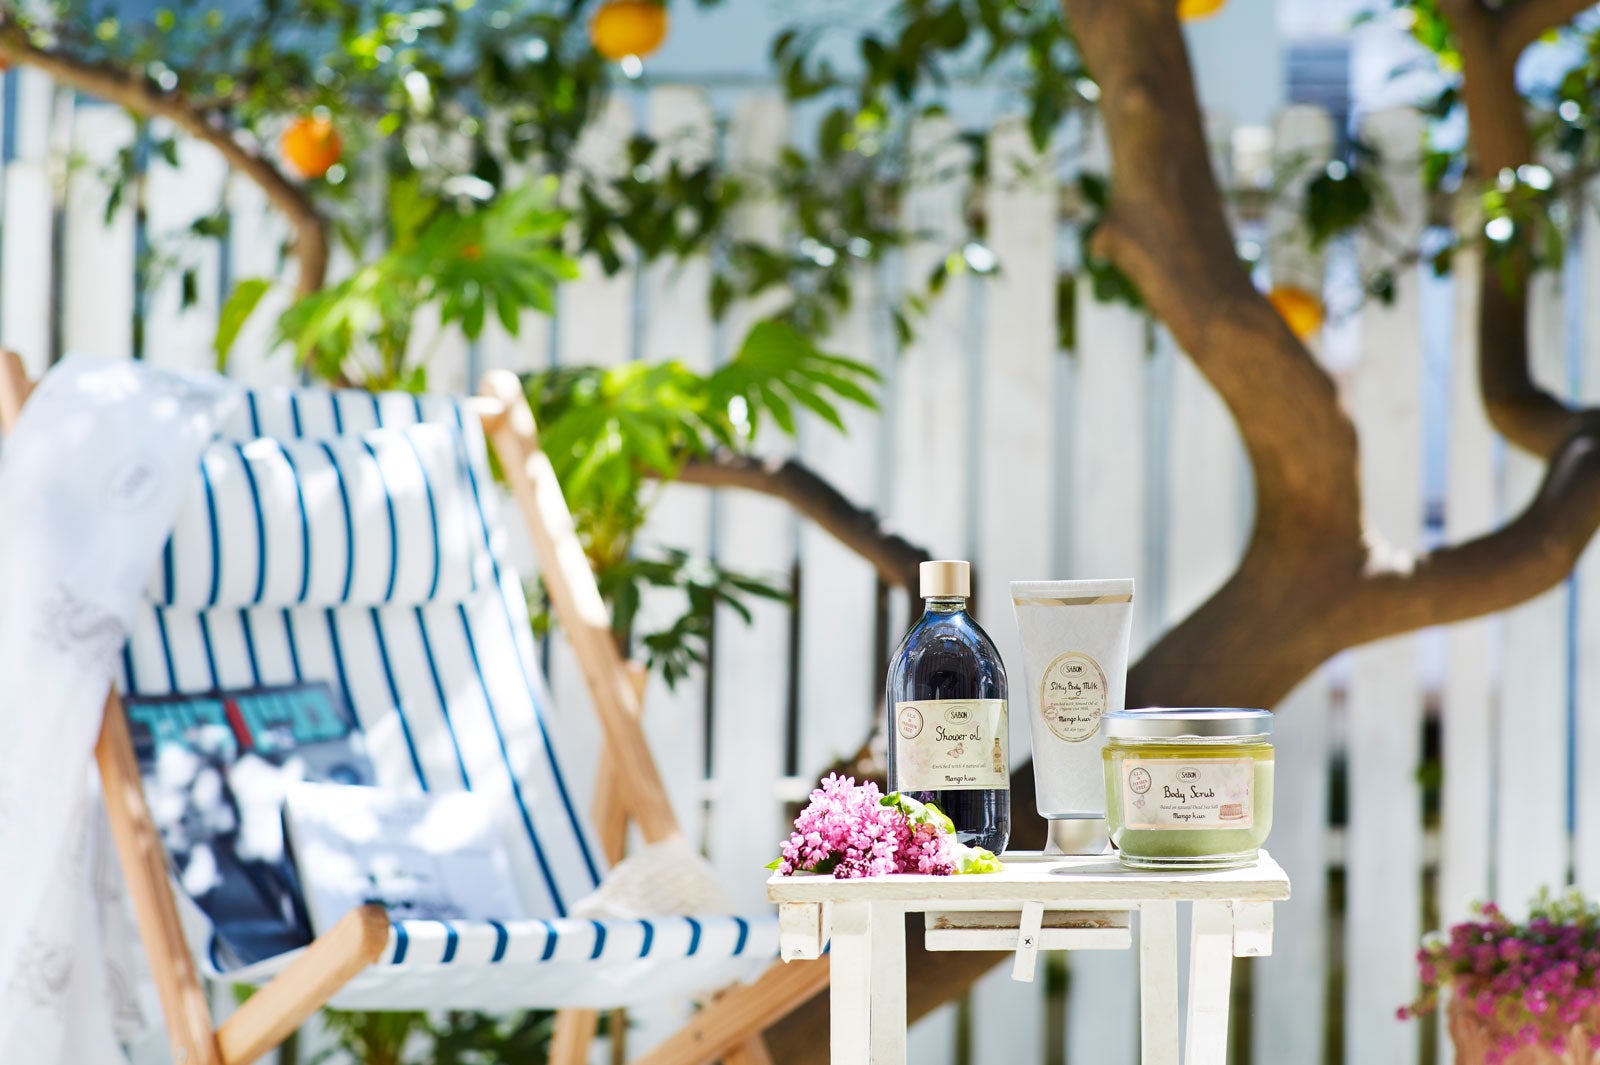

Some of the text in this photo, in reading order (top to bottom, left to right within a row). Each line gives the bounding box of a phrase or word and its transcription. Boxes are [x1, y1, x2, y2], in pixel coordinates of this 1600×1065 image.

[1066, 666, 1082, 674] SABON
[1050, 681, 1098, 696] Silky Body Milk
[950, 711, 968, 720] SABON
[1058, 716, 1077, 725] Mango
[936, 725, 967, 742] Shower
[944, 775, 963, 784] Mango
[1163, 785, 1215, 803] Body Scrub
[1173, 812, 1192, 822] Mango
